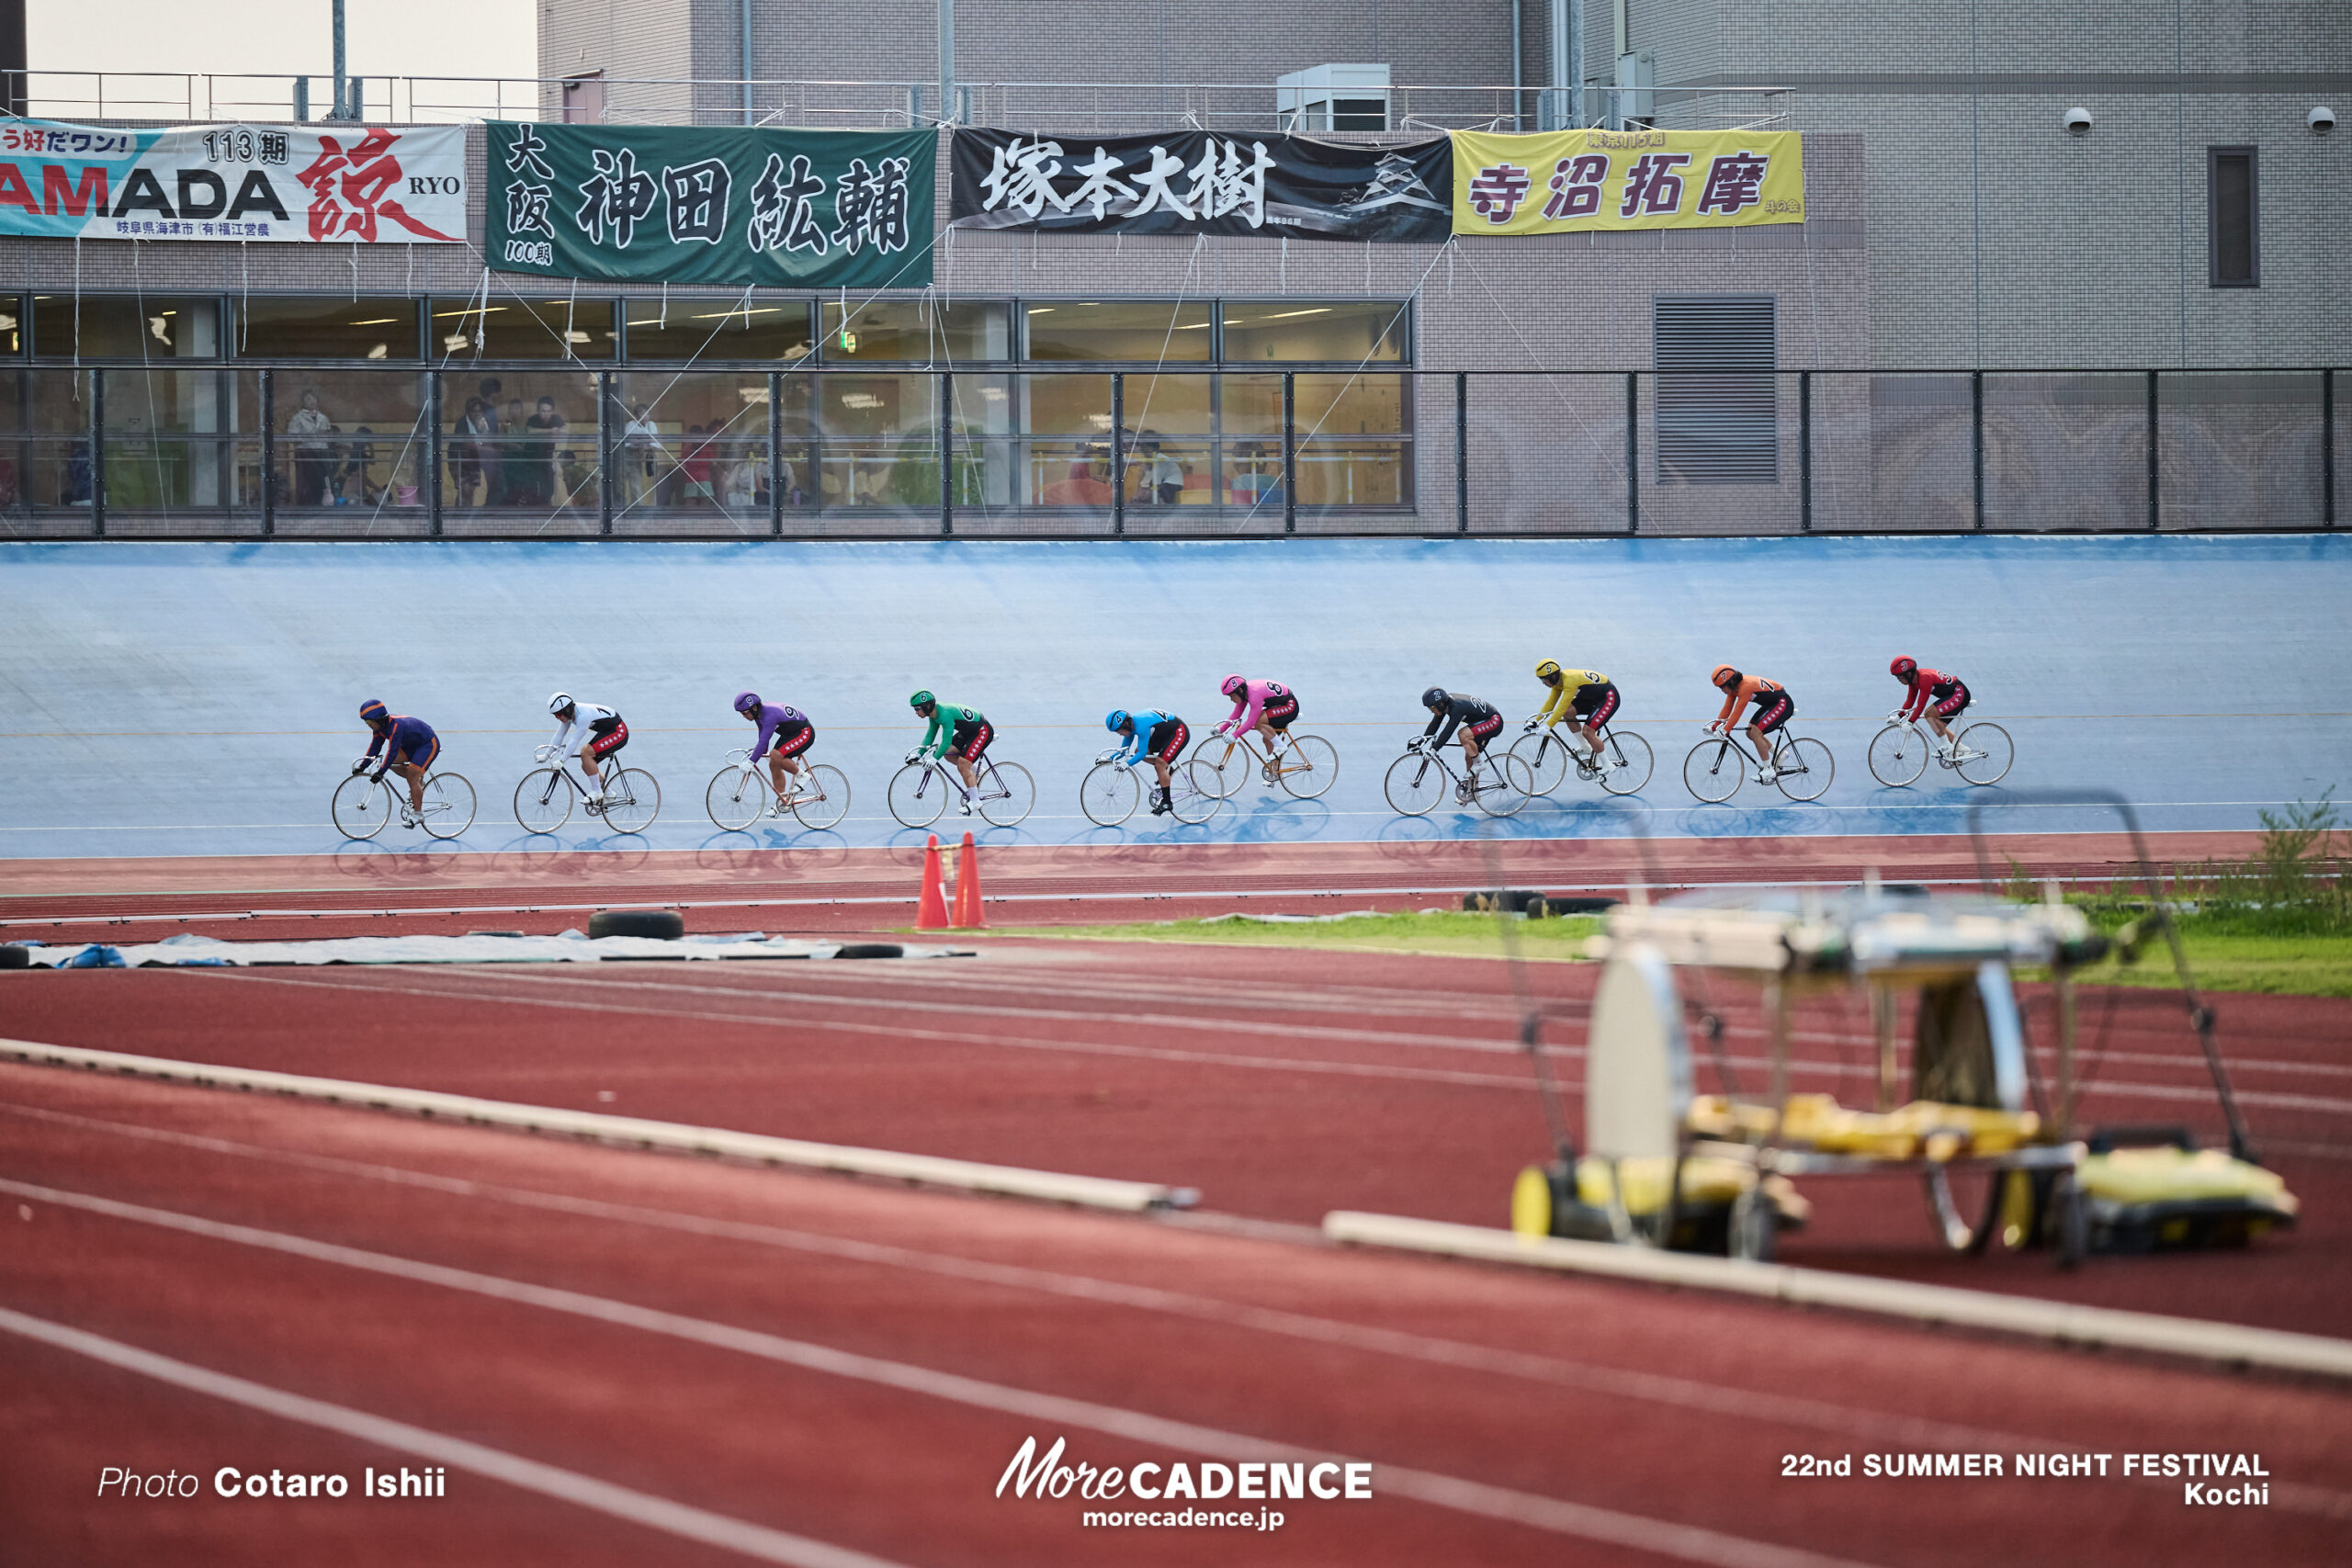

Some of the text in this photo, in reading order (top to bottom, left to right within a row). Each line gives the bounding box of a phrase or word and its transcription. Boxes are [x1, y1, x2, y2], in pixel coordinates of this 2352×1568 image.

[409, 175, 459, 195] RYO
[505, 123, 555, 239] 大阪
[979, 138, 1277, 230] 塚本大樹
[1584, 671, 1600, 685] 5
[1759, 678, 1776, 693] 7
[1938, 671, 1951, 685] 3
[1267, 681, 1283, 697] 8
[596, 707, 616, 718] 1
[784, 705, 799, 719] 9
[1470, 696, 1487, 714] 2
[960, 705, 974, 721] 6
[1150, 709, 1169, 723] 4
